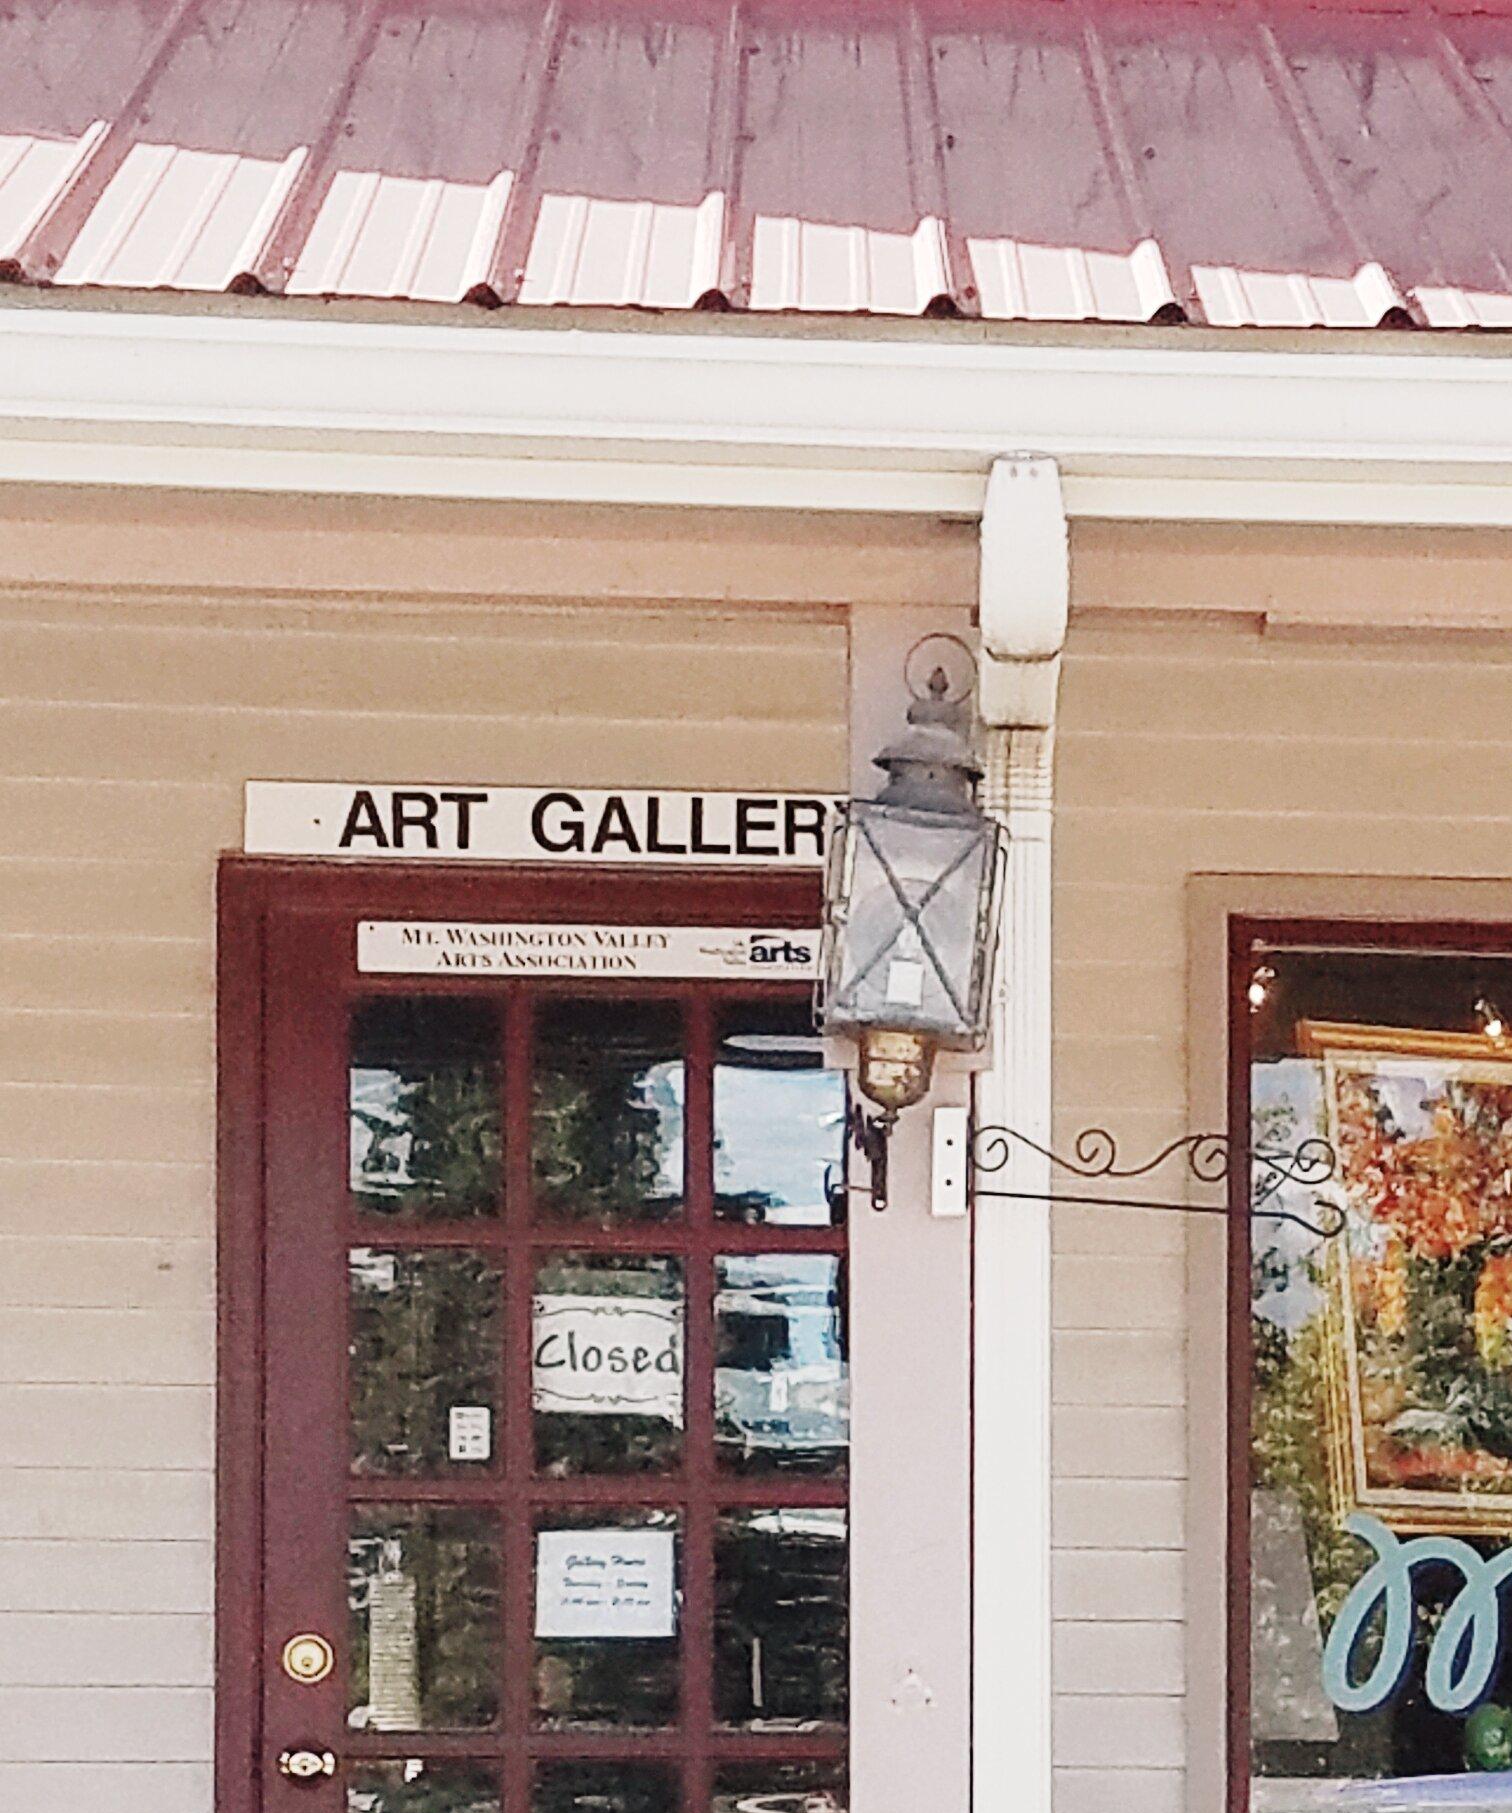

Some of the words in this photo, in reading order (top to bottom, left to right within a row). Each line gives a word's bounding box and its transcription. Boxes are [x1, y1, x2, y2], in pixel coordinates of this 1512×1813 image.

[338, 790, 488, 850] ART
[530, 793, 847, 857] GALLER
[446, 928, 586, 948] WASHINGTON
[593, 930, 668, 949] VALLEY
[437, 951, 493, 968] ARTS
[498, 951, 637, 970] ASSOCIATION
[749, 940, 812, 964] arts
[534, 1330, 680, 1375] Closed
